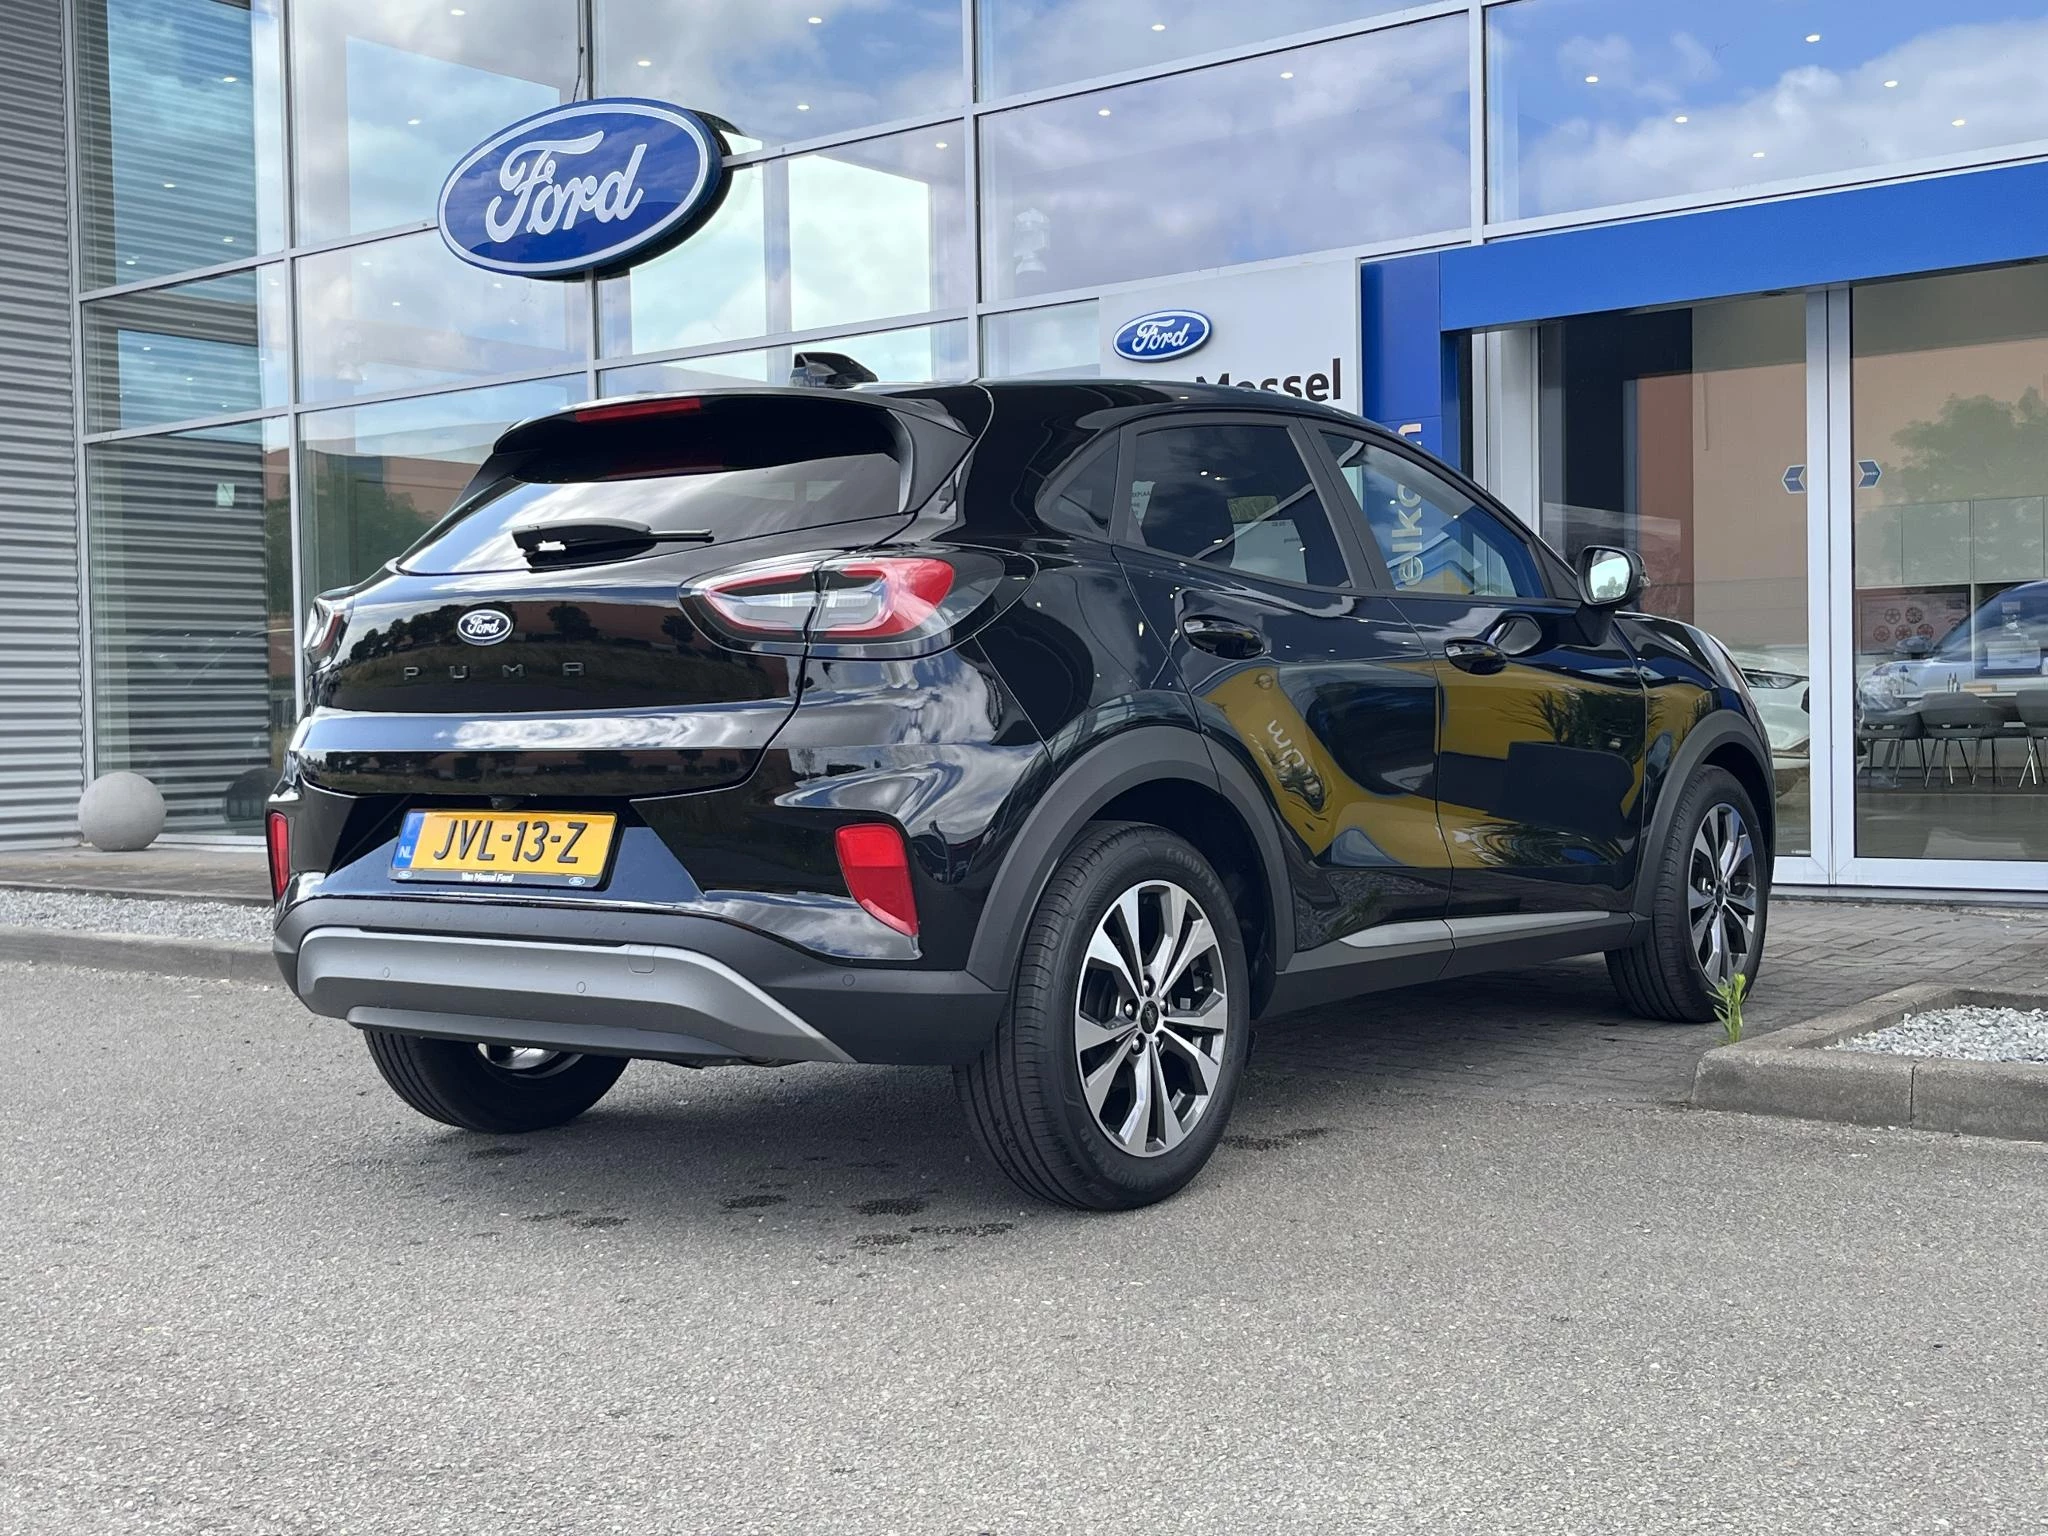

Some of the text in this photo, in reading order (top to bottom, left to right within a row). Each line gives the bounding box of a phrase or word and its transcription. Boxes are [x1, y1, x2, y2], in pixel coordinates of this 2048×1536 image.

[486, 131, 647, 243] Ford
[1132, 318, 1190, 353] Ford
[1195, 358, 1341, 402] ssel
[467, 614, 500, 635] Ford
[403, 662, 585, 681] PUMA
[399, 846, 411, 858] NL
[433, 819, 588, 864] JVL-13-Z
